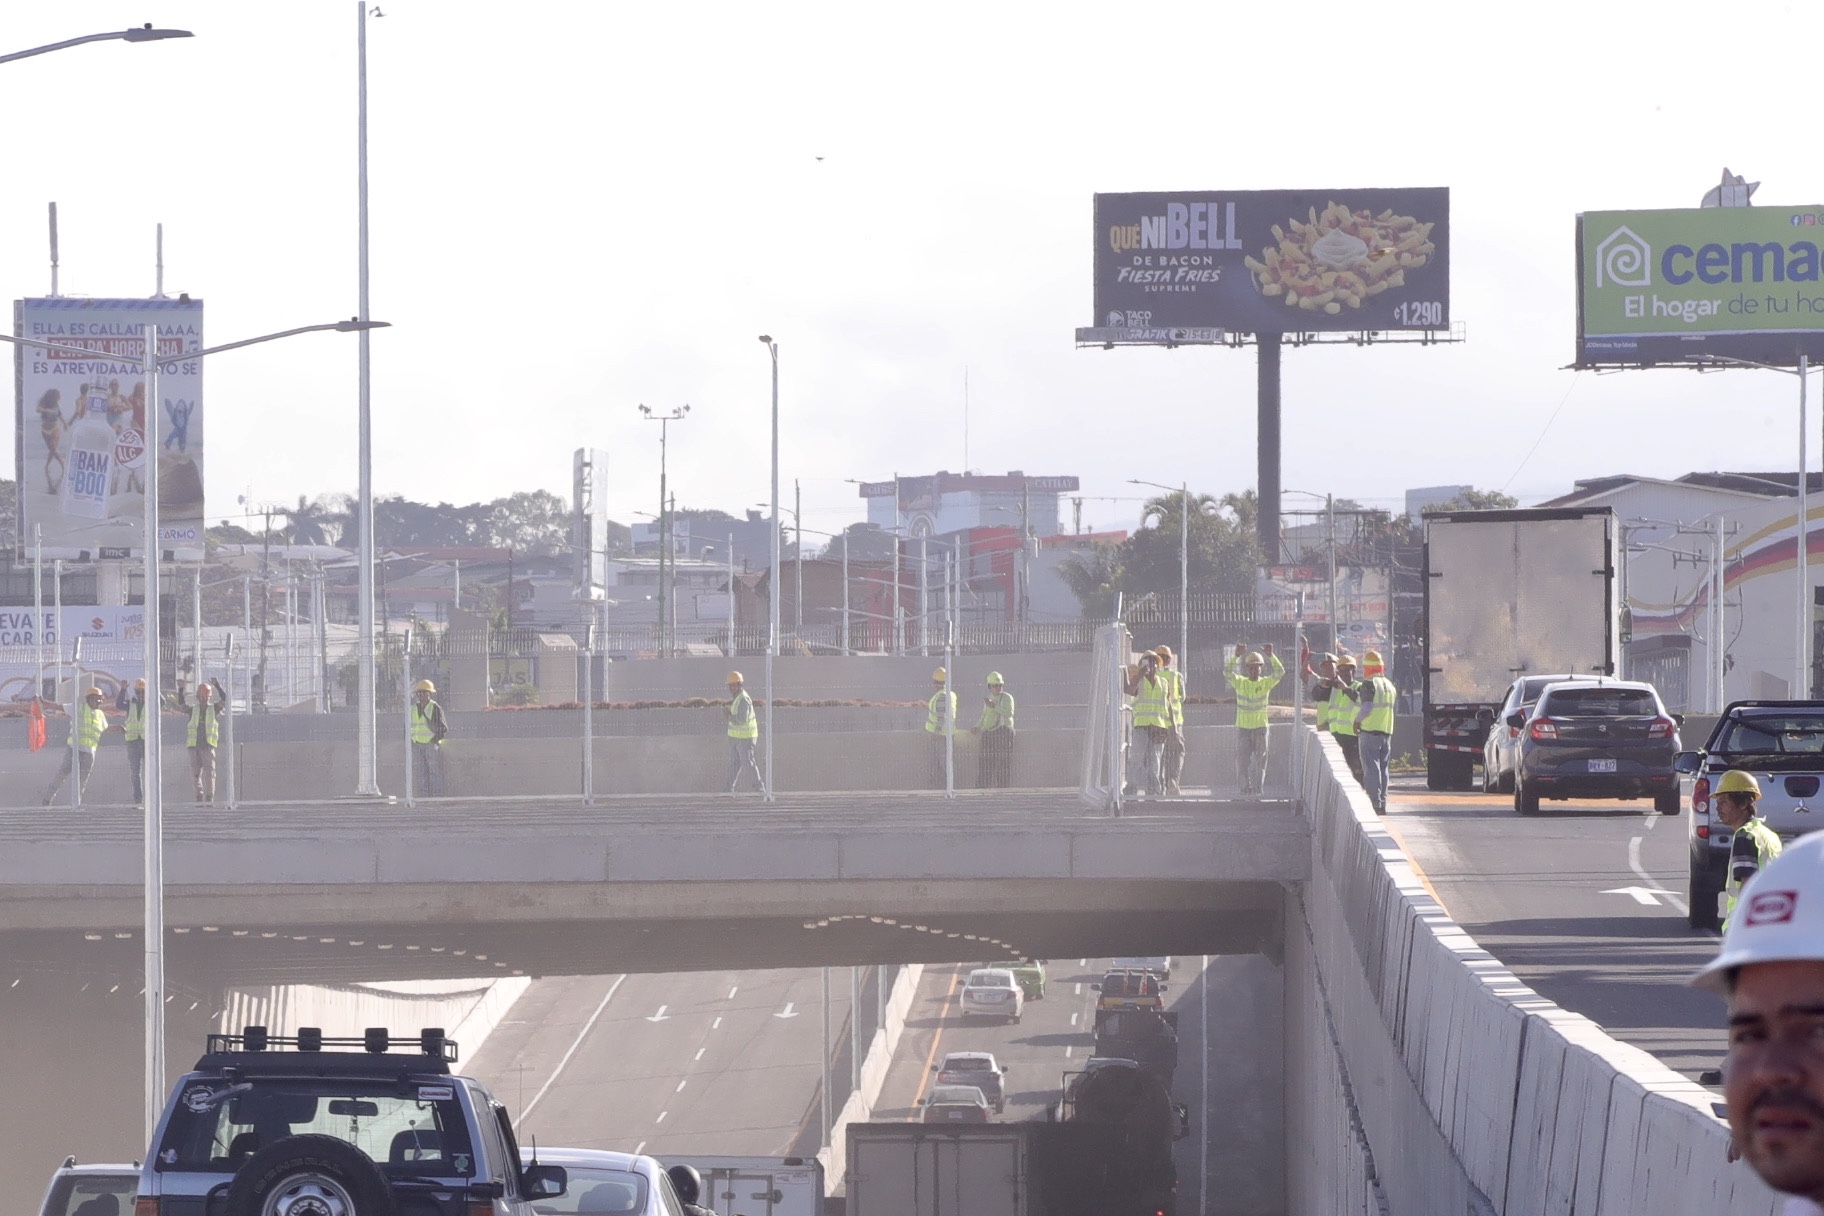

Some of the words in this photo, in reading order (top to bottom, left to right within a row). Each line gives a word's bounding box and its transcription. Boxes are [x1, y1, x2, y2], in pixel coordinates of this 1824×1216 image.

[1133, 256, 1152, 266] DE
[1160, 256, 1213, 266] BACON
[1661, 241, 1824, 286] cema
[1625, 295, 1645, 318] El
[1652, 294, 1722, 323] hogar
[1728, 292, 1759, 314] de
[1764, 294, 1788, 313] tu
[1127, 311, 1152, 320] TACO
[33, 323, 64, 335] ELLA
[70, 323, 85, 335] ES
[88, 323, 199, 337] CALLAITAAAA,
[1127, 319, 1149, 328] BELL
[33, 362, 49, 375] ES
[182, 359, 198, 375] SÉ
[78, 450, 109, 474] BAM
[74, 471, 106, 496] BOO
[1035, 479, 1073, 489] CATHAY
[1, 632, 56, 646] CARO
